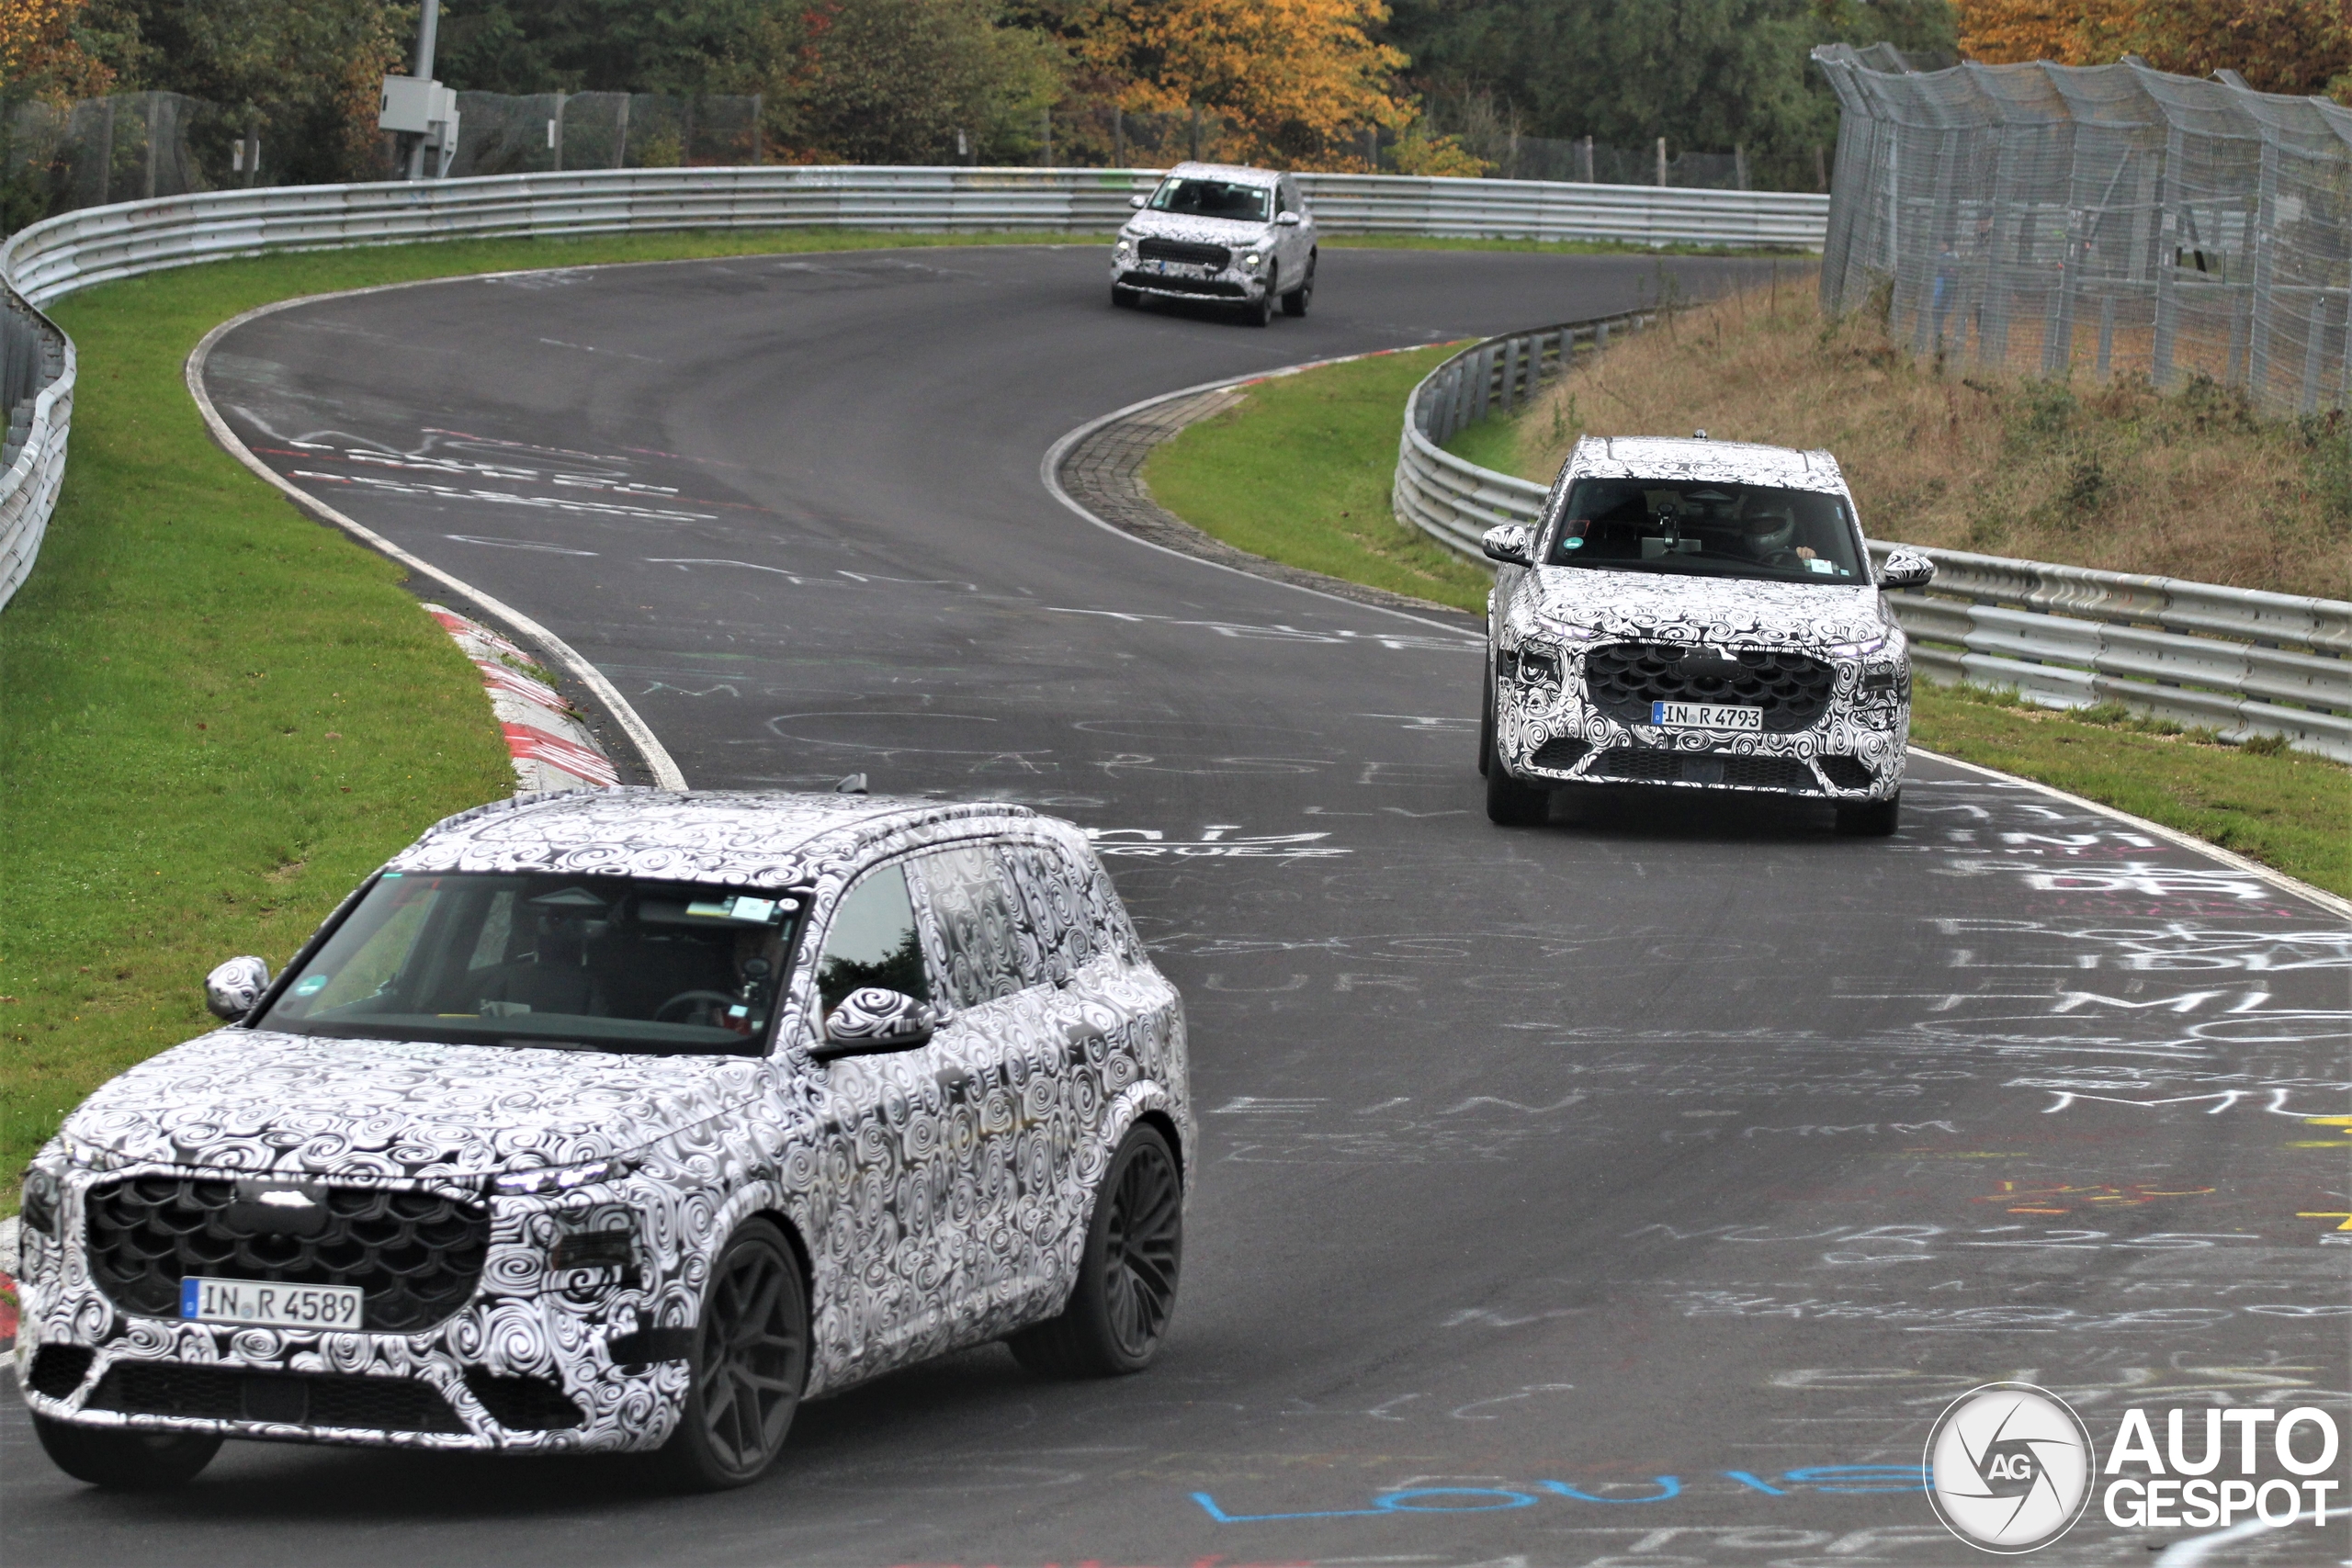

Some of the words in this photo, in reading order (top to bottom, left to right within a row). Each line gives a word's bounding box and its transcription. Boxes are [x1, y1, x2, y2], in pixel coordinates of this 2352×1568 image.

[1665, 705, 1688, 724] IN
[1700, 707, 1711, 725] R
[1715, 708, 1759, 728] 4793
[203, 1285, 238, 1316] IN
[258, 1288, 275, 1318] R
[284, 1291, 356, 1323] 4589
[1188, 1464, 1936, 1523] LOUIS
